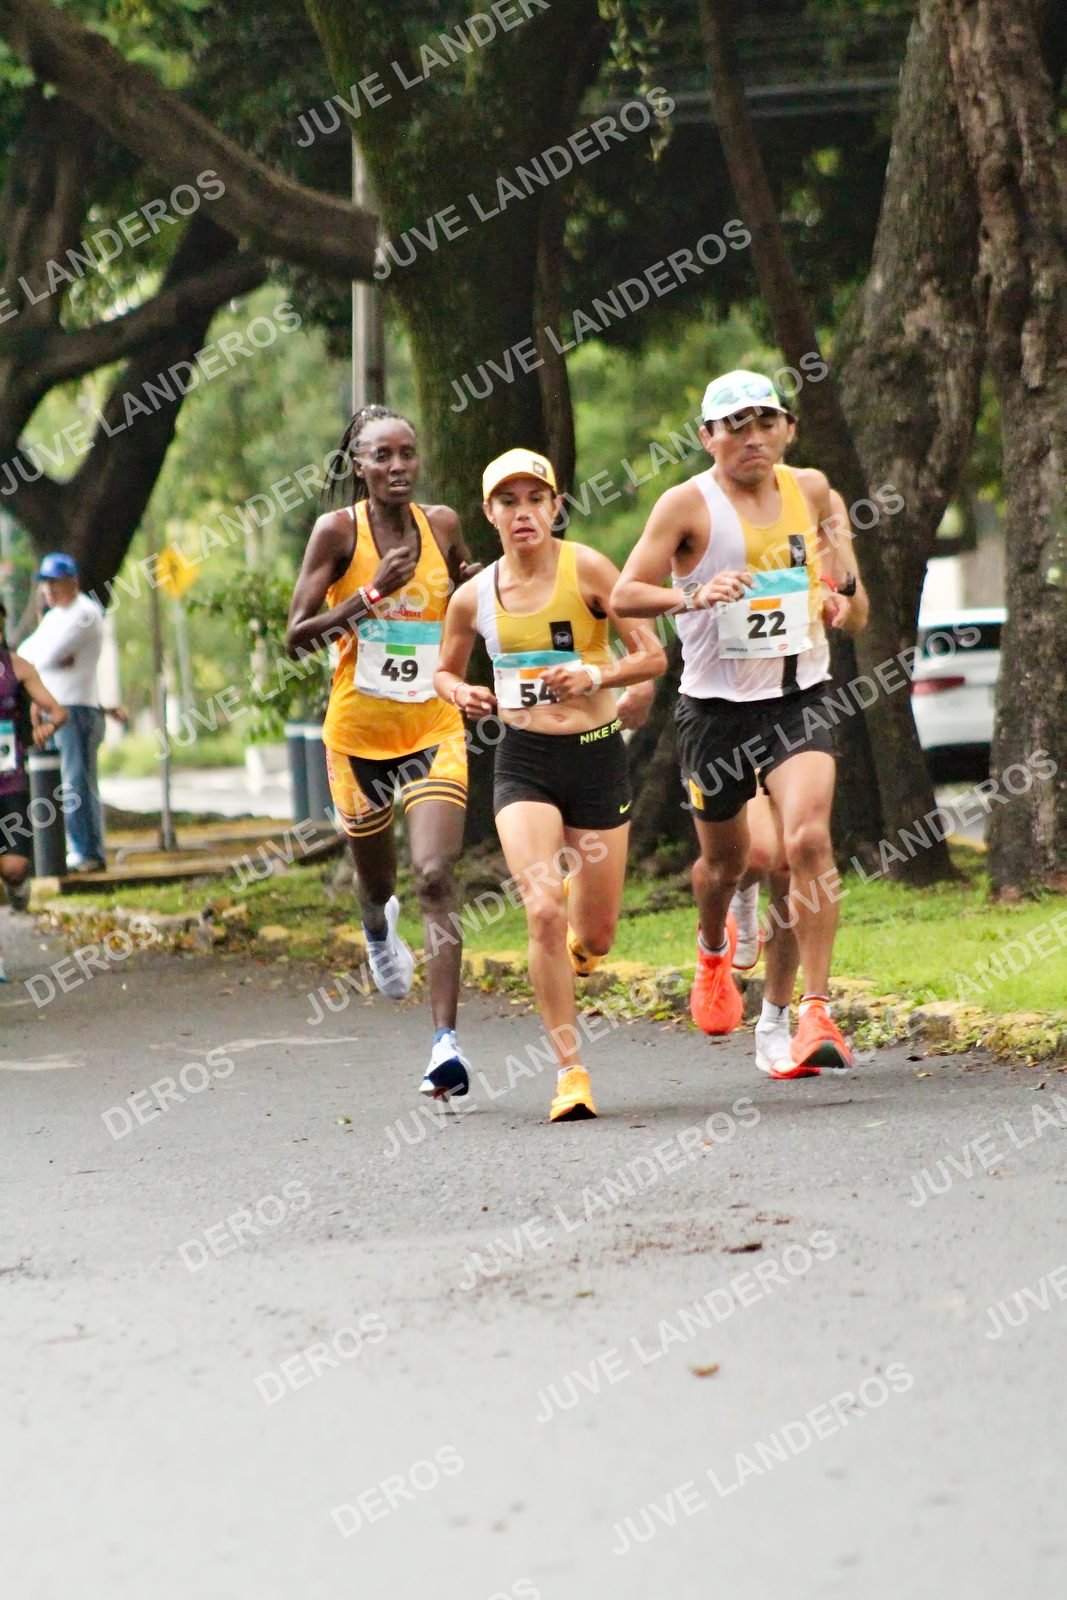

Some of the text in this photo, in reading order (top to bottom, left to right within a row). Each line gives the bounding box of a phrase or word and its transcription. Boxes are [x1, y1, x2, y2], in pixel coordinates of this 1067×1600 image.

[746, 610, 787, 640] 22
[381, 658, 419, 683] 49
[519, 681, 558, 708] 54
[580, 725, 609, 745] NIKE
